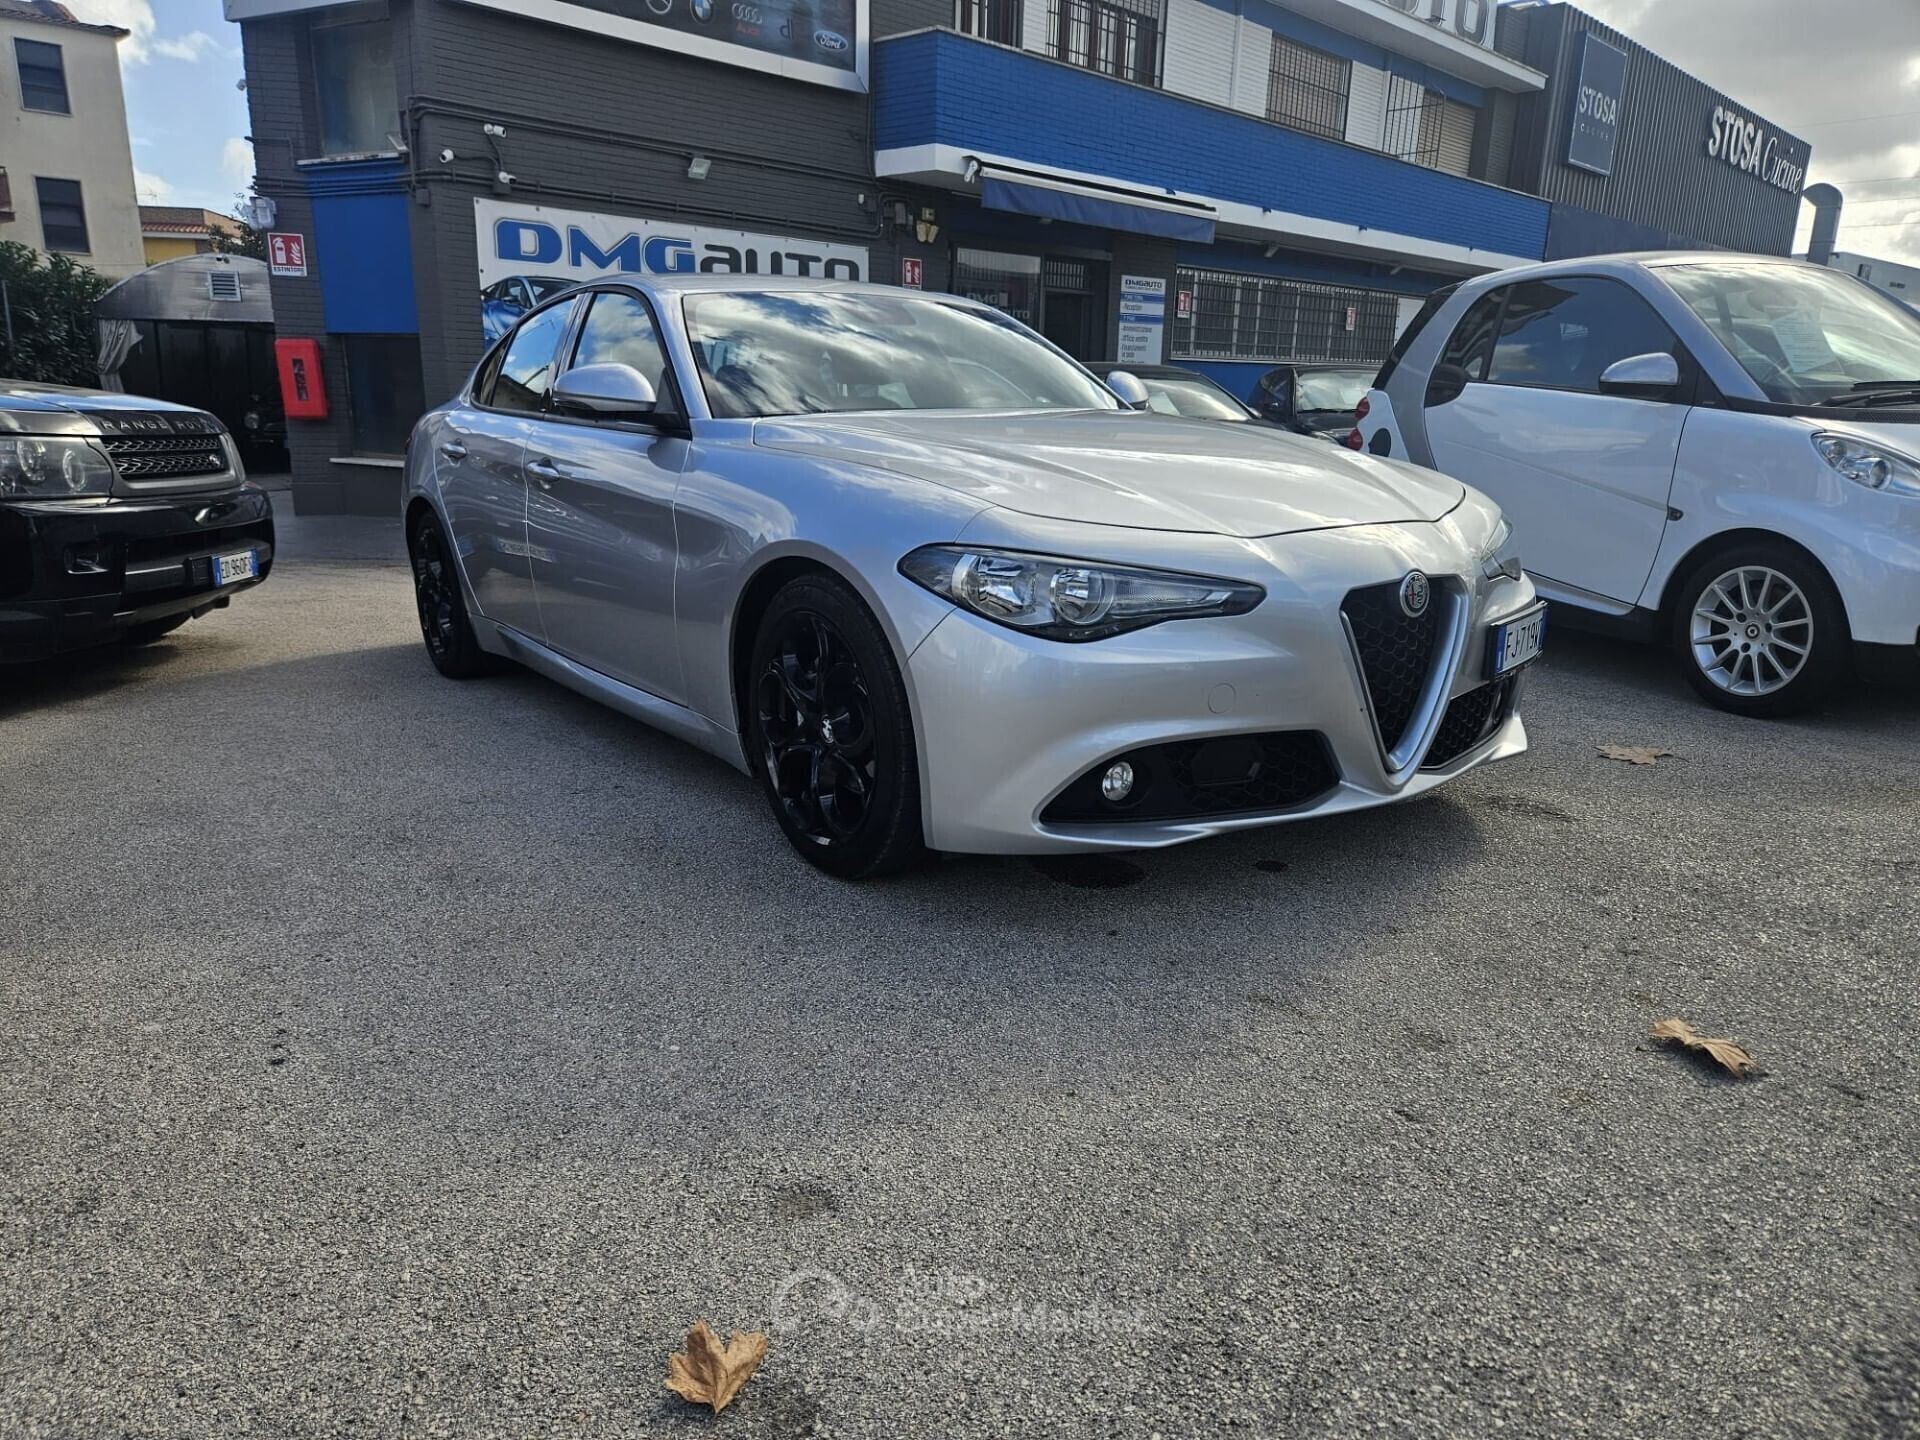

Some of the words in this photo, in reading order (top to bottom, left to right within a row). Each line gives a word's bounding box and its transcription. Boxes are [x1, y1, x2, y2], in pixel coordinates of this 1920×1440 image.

[818, 34, 842, 49] Ford
[1579, 85, 1616, 126] STOSA
[1708, 105, 1763, 176] STOSA
[1761, 136, 1802, 194] Cucine
[101, 420, 169, 430] RANGE
